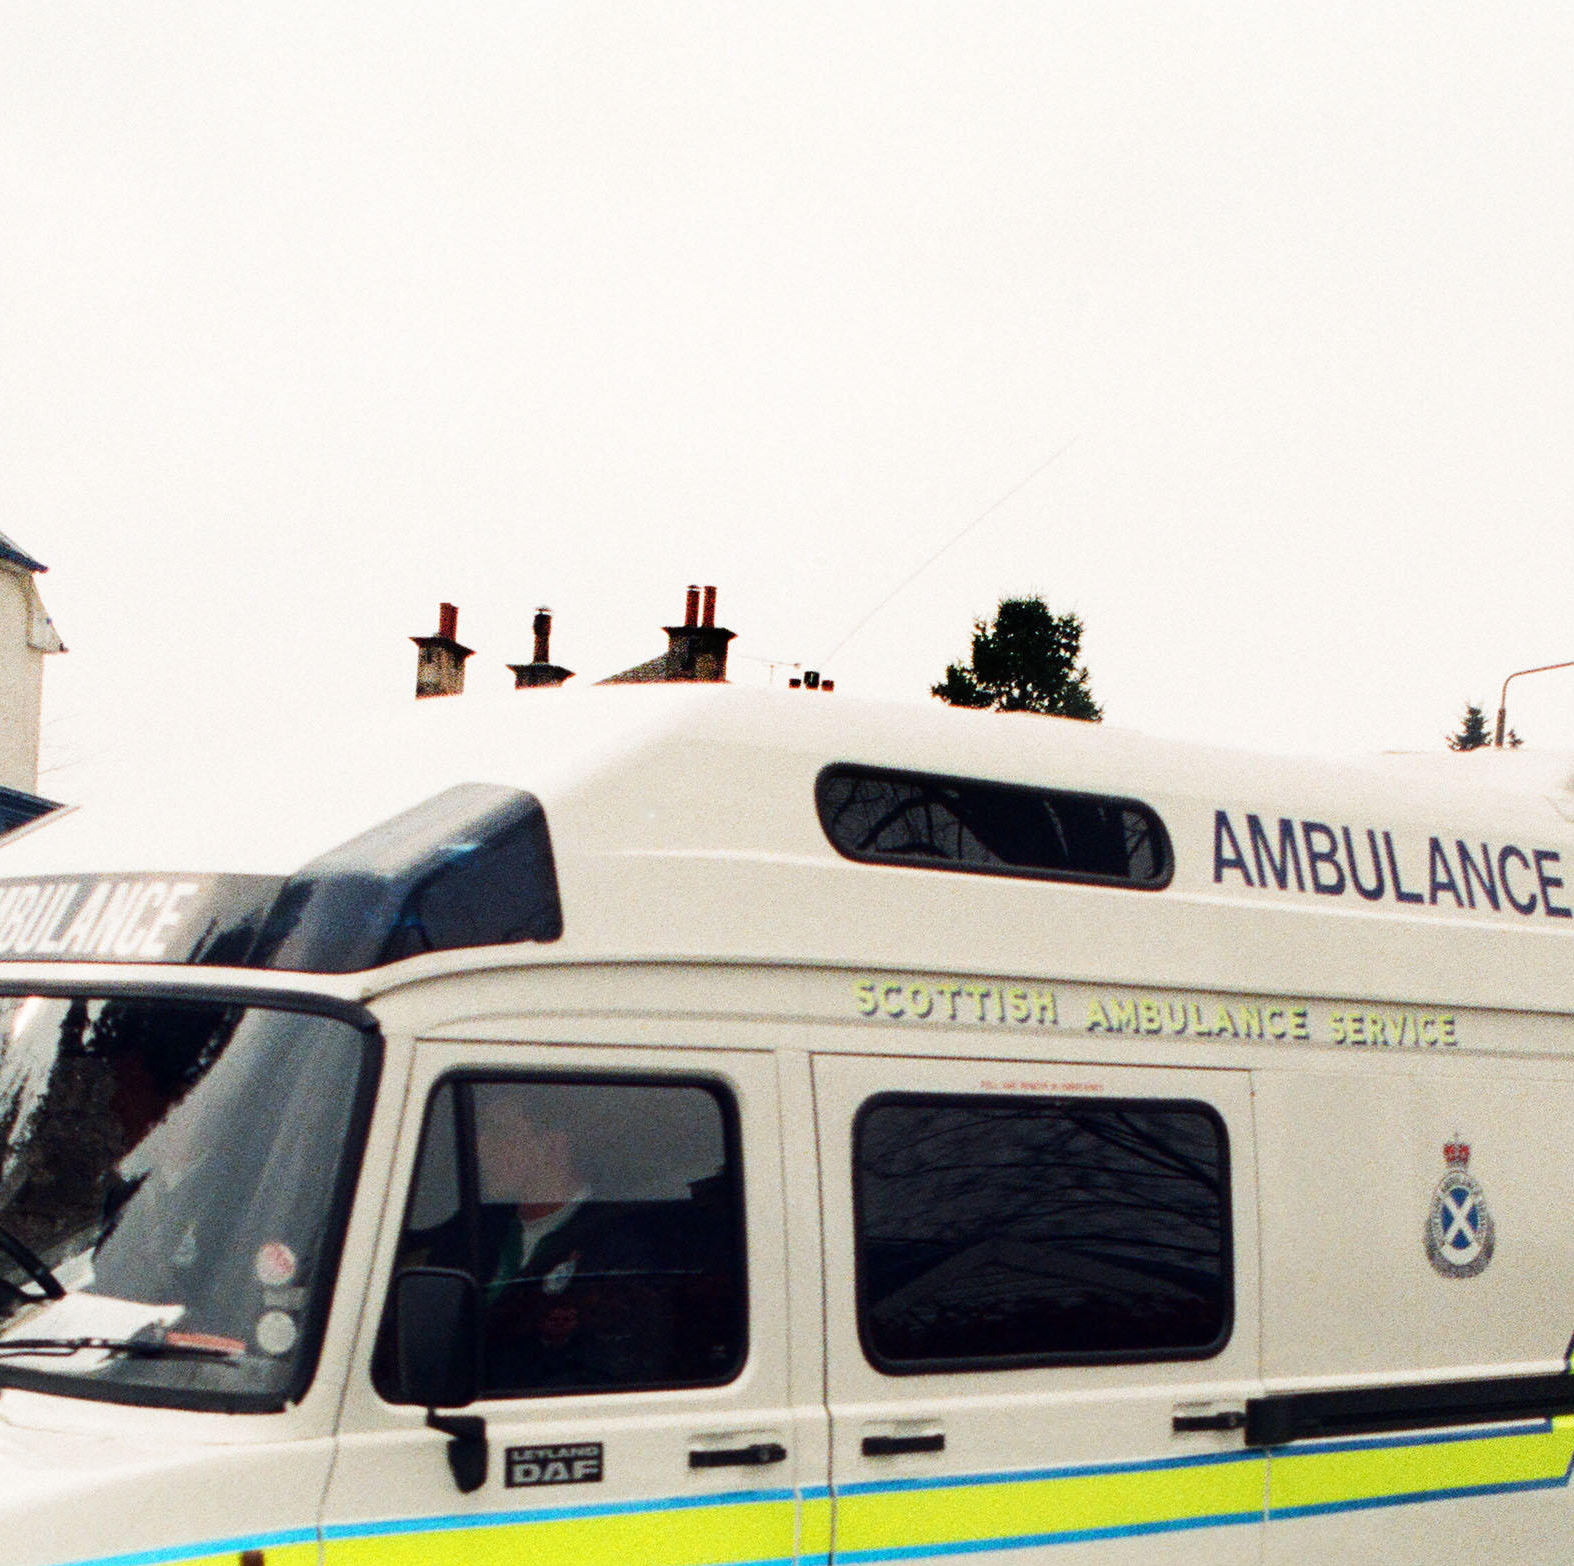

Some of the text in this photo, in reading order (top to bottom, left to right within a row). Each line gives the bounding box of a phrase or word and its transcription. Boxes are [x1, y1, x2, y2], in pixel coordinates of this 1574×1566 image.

[1214, 810, 1573, 918] AMBULANCE
[852, 977, 1458, 1048] SCOTTISH AMBULANCE SERVICE
[511, 1446, 599, 1462] LEYLAND
[512, 1460, 599, 1483] DAF
